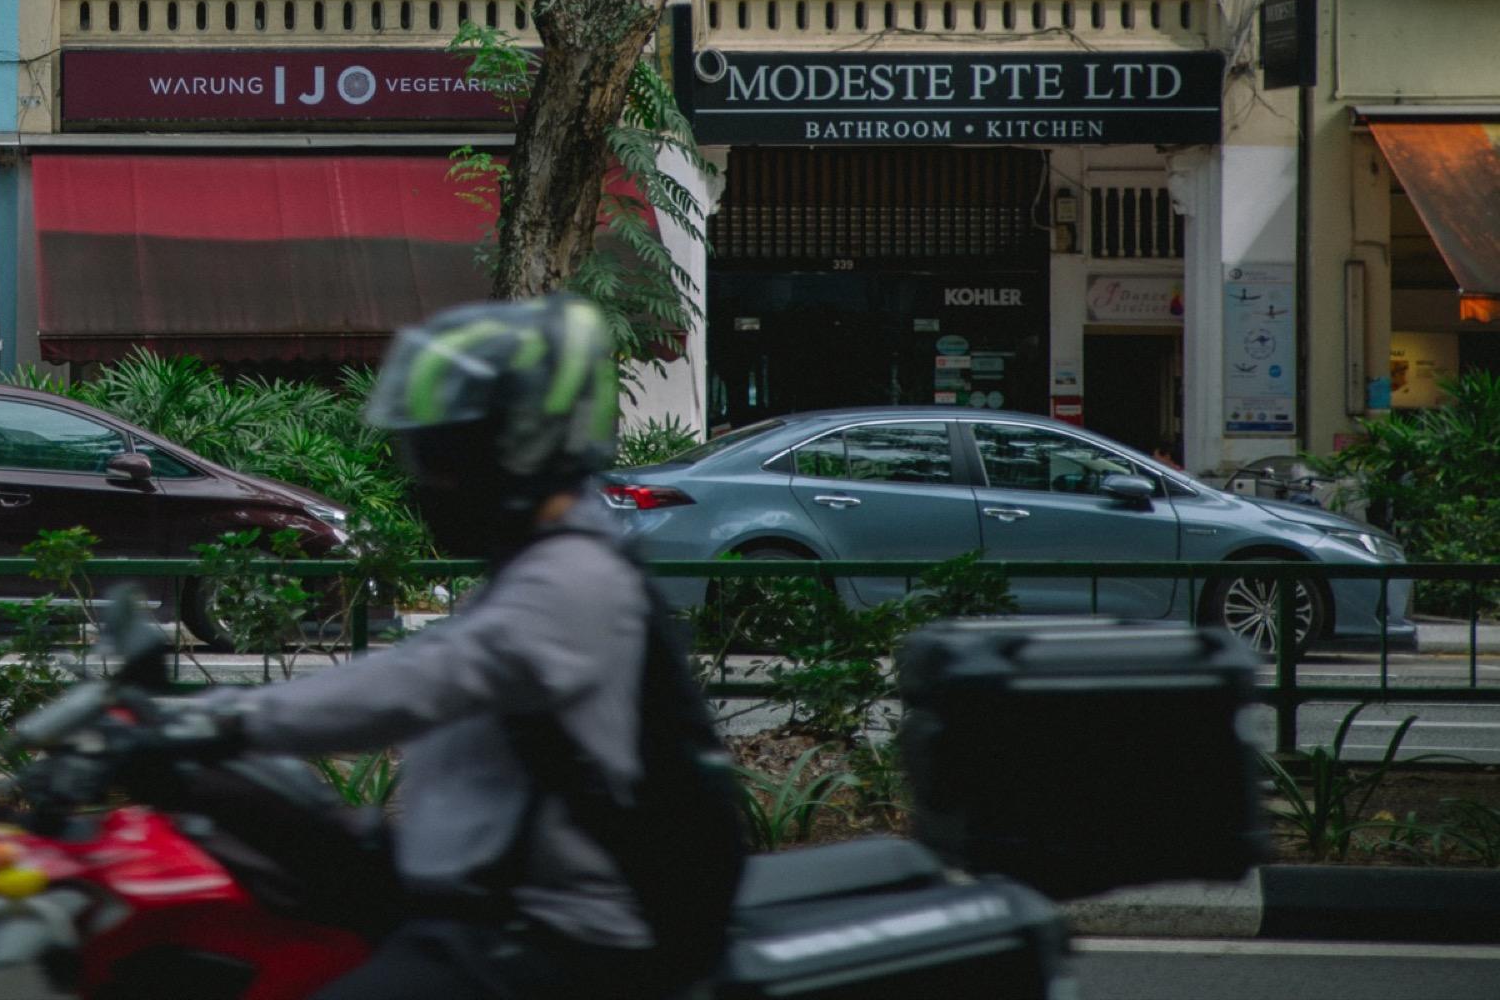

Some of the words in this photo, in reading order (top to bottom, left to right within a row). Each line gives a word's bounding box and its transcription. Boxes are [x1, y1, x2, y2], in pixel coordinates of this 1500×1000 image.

[149, 77, 263, 95] WARUNG
[726, 64, 955, 102] MODESTE
[969, 64, 1064, 101] PTE
[1083, 63, 1182, 101] LTD
[804, 120, 952, 140] BATHROOM
[986, 119, 1105, 140] KITCHEN
[832, 259, 854, 271] 339
[944, 287, 1022, 306] KOHLER
